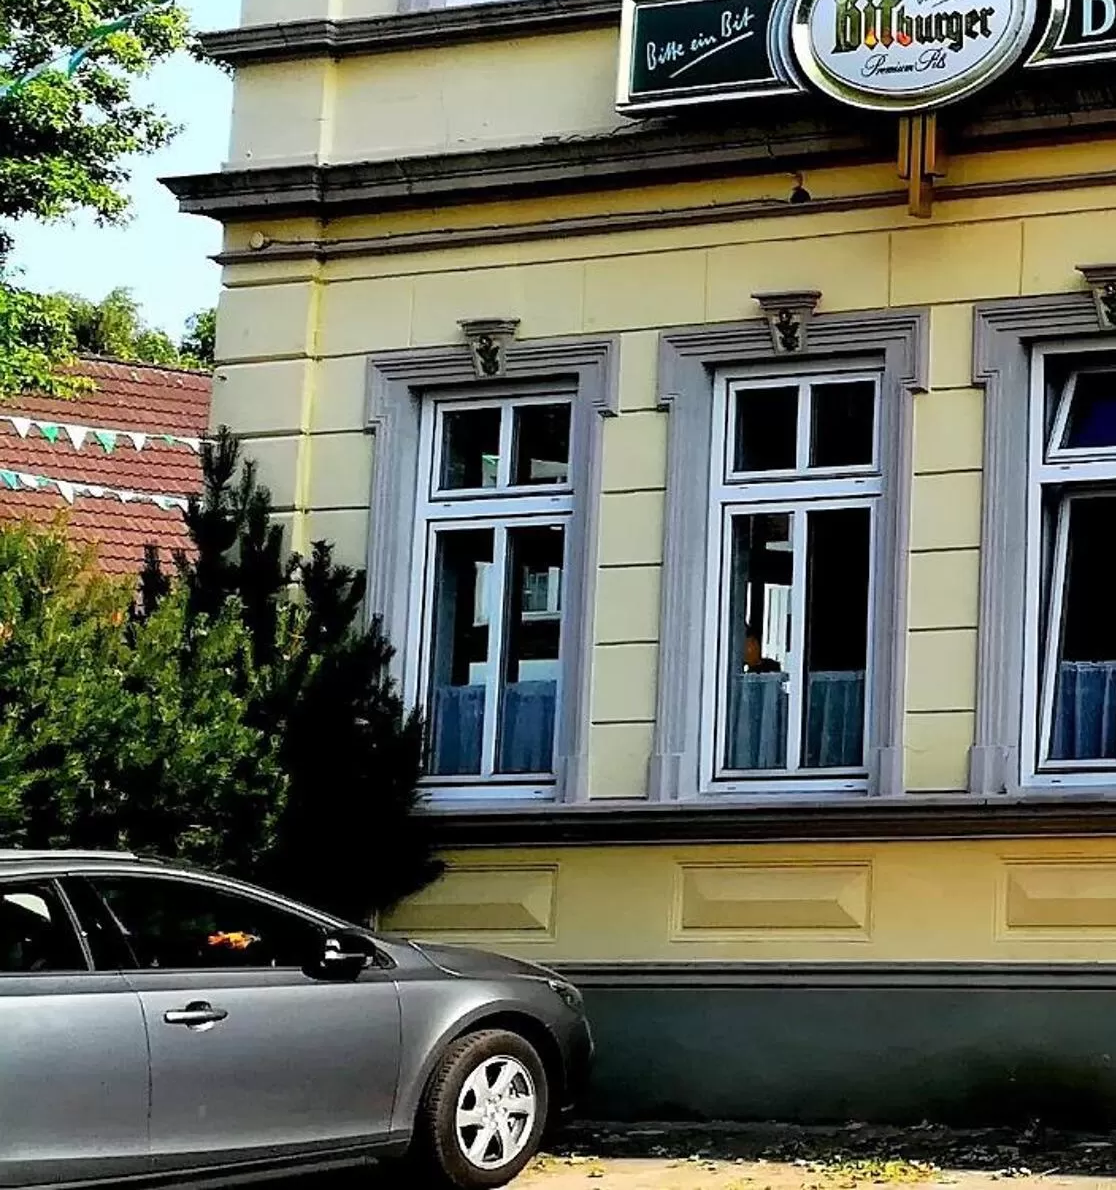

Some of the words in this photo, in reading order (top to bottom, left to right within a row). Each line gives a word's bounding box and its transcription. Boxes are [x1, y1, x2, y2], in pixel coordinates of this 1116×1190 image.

[646, 41, 685, 71] Bitte
[690, 32, 717, 51] ein
[721, 6, 755, 38] Bit
[860, 53, 915, 78] Premium
[915, 47, 948, 72] Pils
